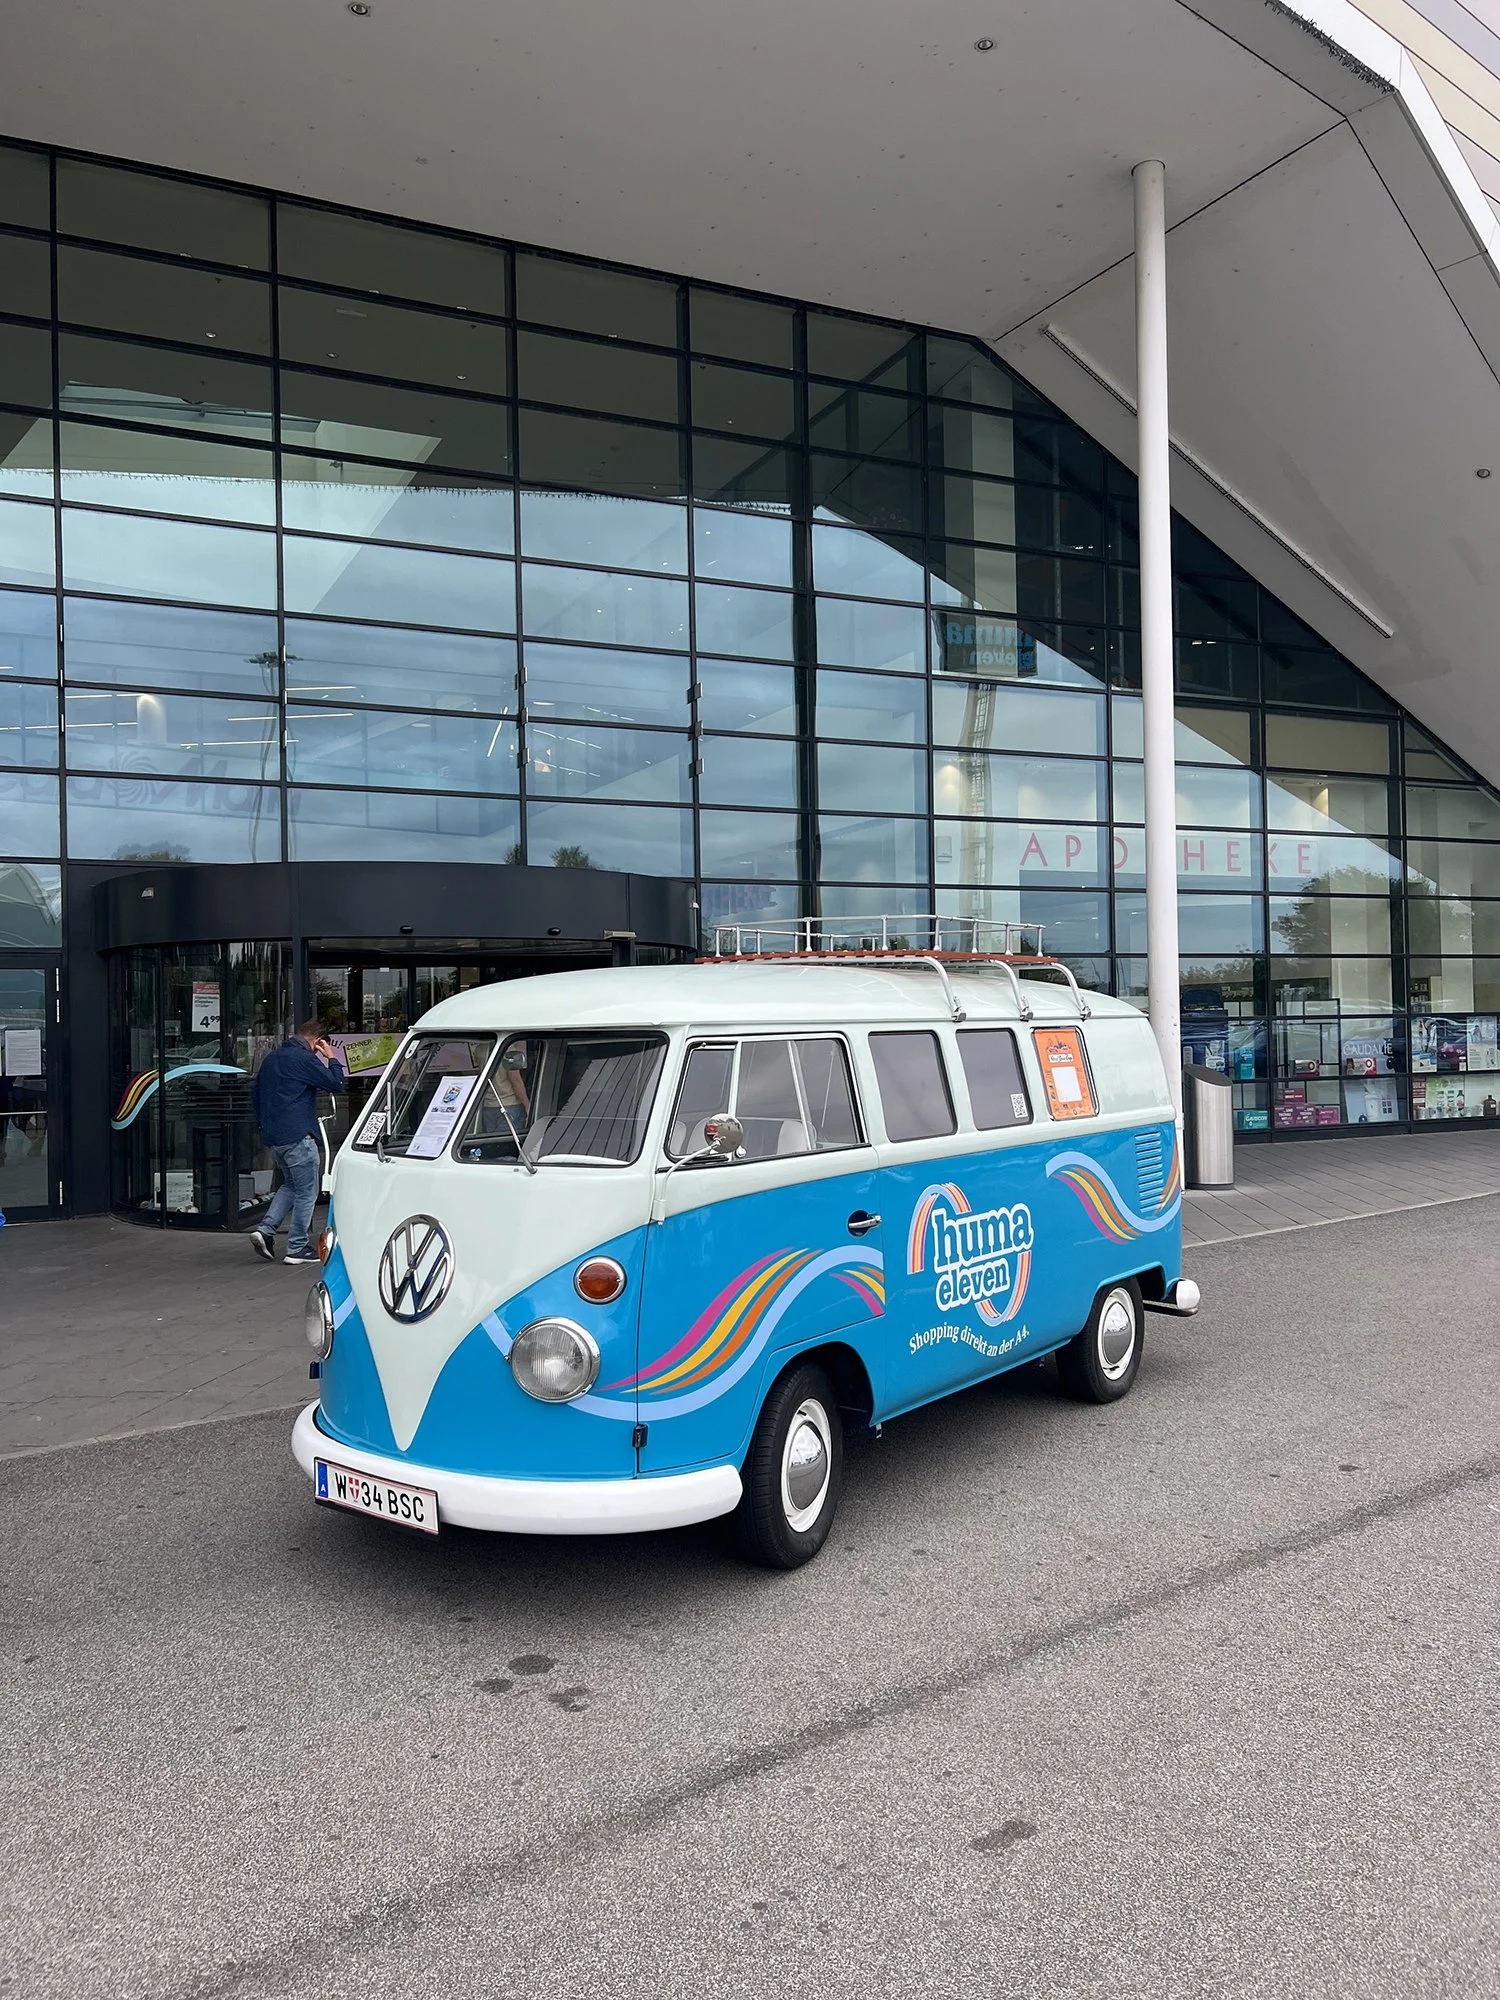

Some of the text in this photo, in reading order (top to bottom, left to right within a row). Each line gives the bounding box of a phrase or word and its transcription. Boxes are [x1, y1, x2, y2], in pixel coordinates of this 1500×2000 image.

[1020, 831, 1312, 875] APOHEKE
[346, 1038, 372, 1051] ZEHNER
[931, 1203, 1034, 1274] huma
[380, 1215, 455, 1324] VW
[936, 1258, 1010, 1311] eleven
[909, 1322, 960, 1355] Shopping
[960, 1325, 988, 1355] direkt
[986, 1345, 998, 1357] an
[998, 1337, 1015, 1355] der
[335, 1472, 425, 1522] W 34 BSC
